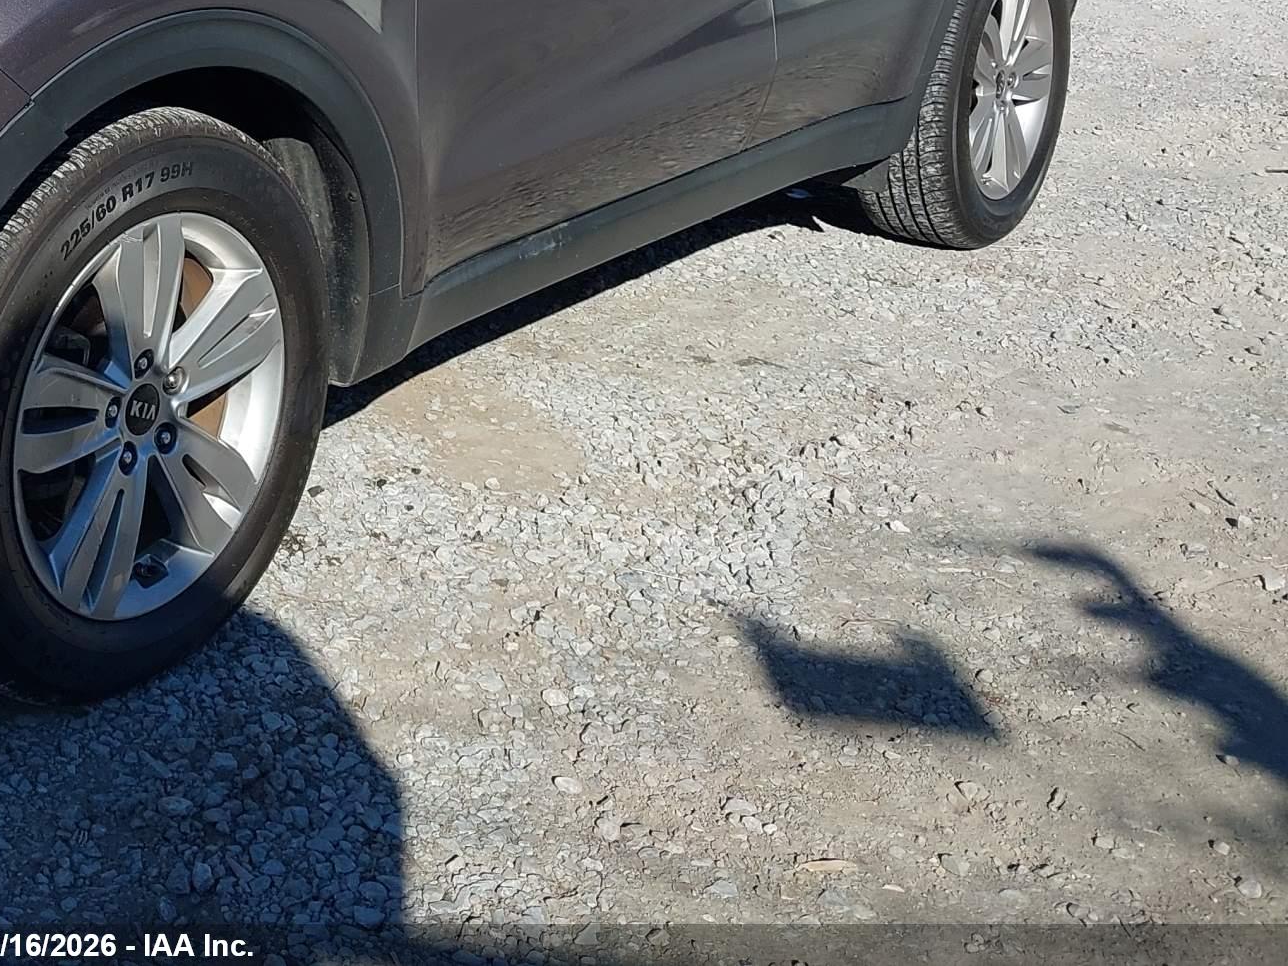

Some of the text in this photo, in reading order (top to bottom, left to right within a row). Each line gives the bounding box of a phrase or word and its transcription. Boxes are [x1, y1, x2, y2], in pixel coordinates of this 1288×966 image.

[60, 194, 117, 261] 225/60
[121, 171, 155, 202] R17
[160, 161, 193, 183] 99H
[130, 399, 156, 421] KIA
